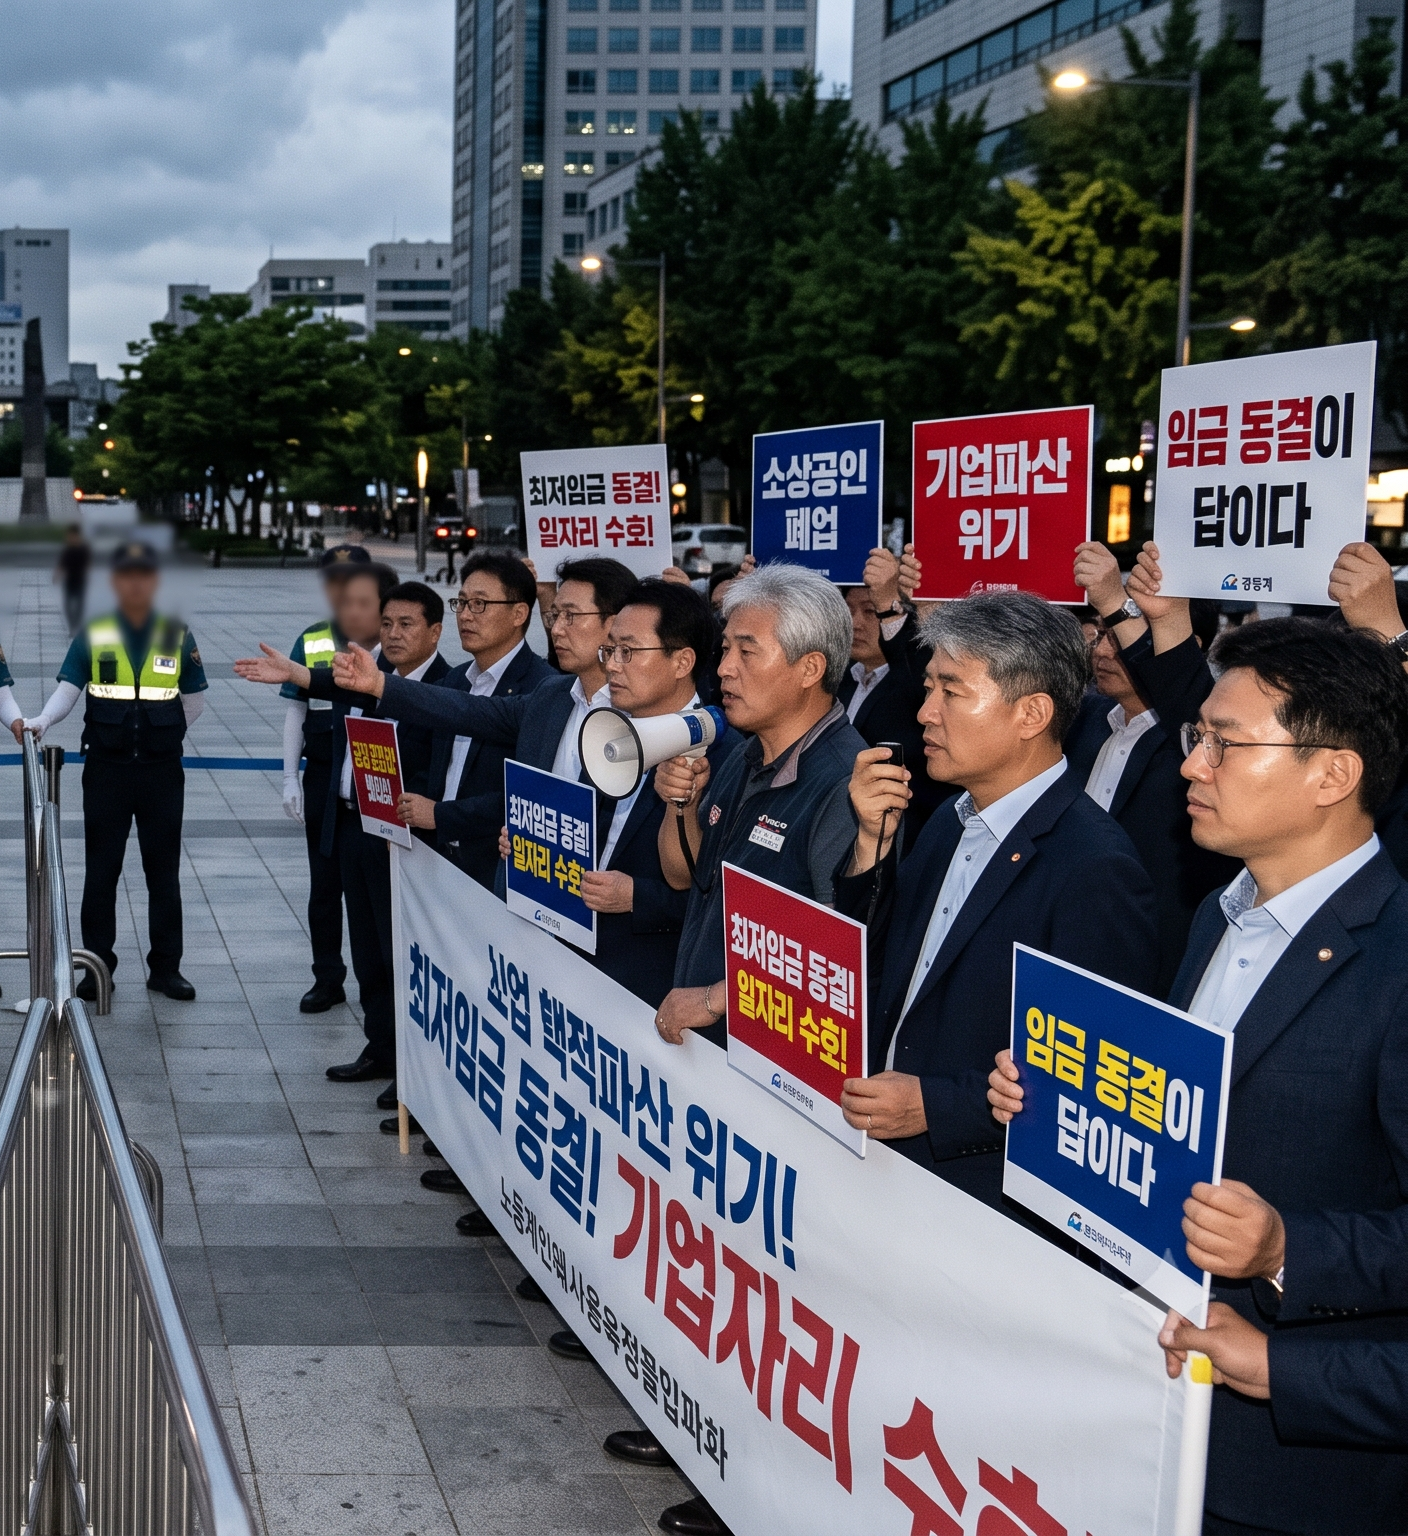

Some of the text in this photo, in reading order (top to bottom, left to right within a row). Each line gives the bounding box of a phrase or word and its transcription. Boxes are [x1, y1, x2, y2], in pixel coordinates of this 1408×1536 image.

[1168, 392, 1355, 469] 임금 동결이
[528, 471, 661, 507] 최저임금 동결!
[762, 448, 867, 500] 소상공인
[925, 436, 1072, 499] 기업파산
[538, 514, 654, 548] 일자리 수호!
[784, 505, 838, 551] 폐업
[958, 506, 1029, 560] 위기
[1193, 481, 1312, 550] 답이다
[509, 793, 590, 858] 최저임금 동결!
[512, 834, 586, 898] 일자리 수호
[730, 911, 856, 1020] 최저임금 동결!
[737, 969, 848, 1075] 일자리 수호!
[1026, 1007, 1205, 1154] 임금 동결이
[1057, 1093, 1157, 1208] 답이다
[408, 941, 507, 1136] 최저임금
[514, 1057, 602, 1238] 동결!
[613, 1153, 861, 1496] 기업자리
[685, 1103, 798, 1271] 위기!
